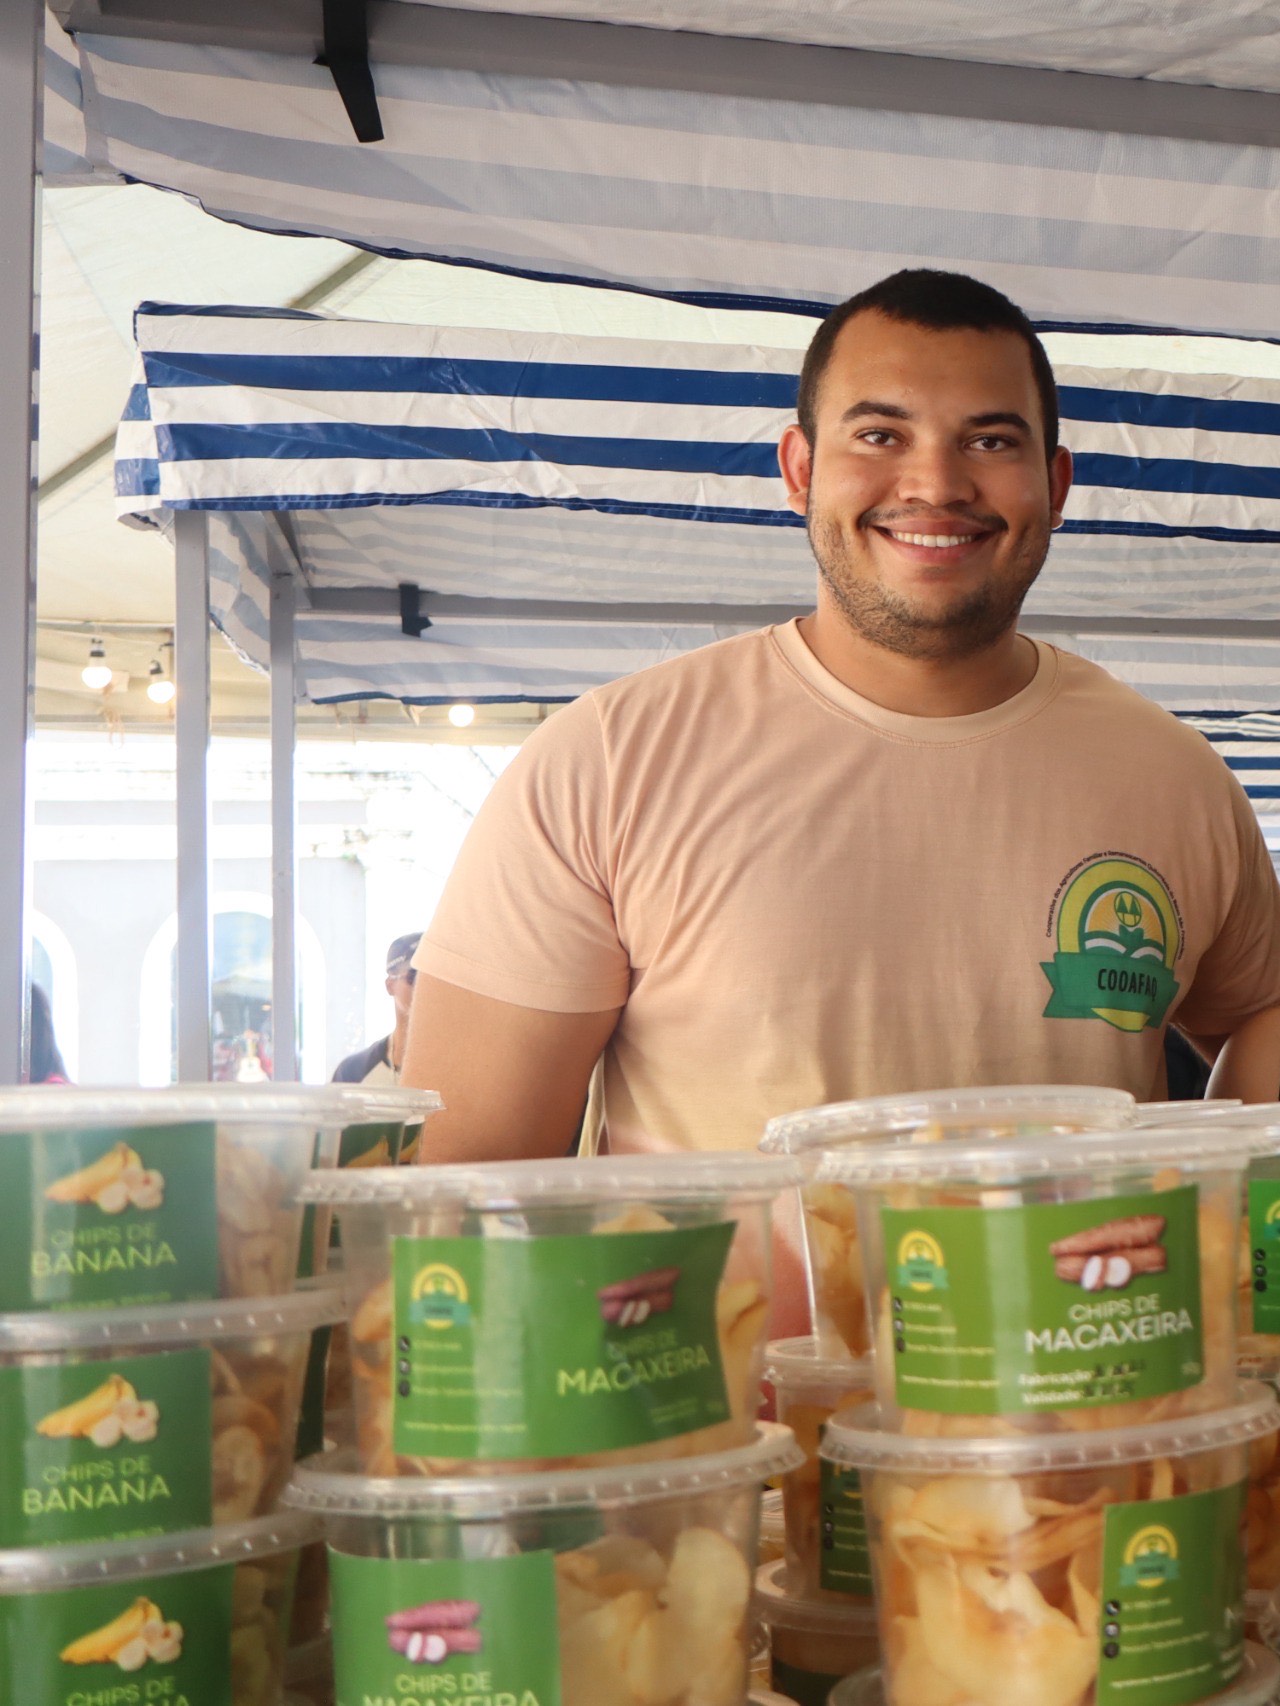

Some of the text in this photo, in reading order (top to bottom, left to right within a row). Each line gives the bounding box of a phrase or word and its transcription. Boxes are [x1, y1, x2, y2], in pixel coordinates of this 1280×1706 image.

[50, 1222, 157, 1247] CHIPS DE
[31, 1241, 178, 1277] BANANA
[1068, 1293, 1160, 1323] CHIPS DE
[1024, 1308, 1194, 1354] MACAXEIRA
[556, 1343, 711, 1397] MACAXEIRA
[41, 1454, 151, 1485] CHIPS DE
[22, 1473, 172, 1517] BANANA
[66, 1684, 140, 1706] CHIPS
[145, 1675, 176, 1699] DE
[396, 1671, 492, 1694] CHIPS DE
